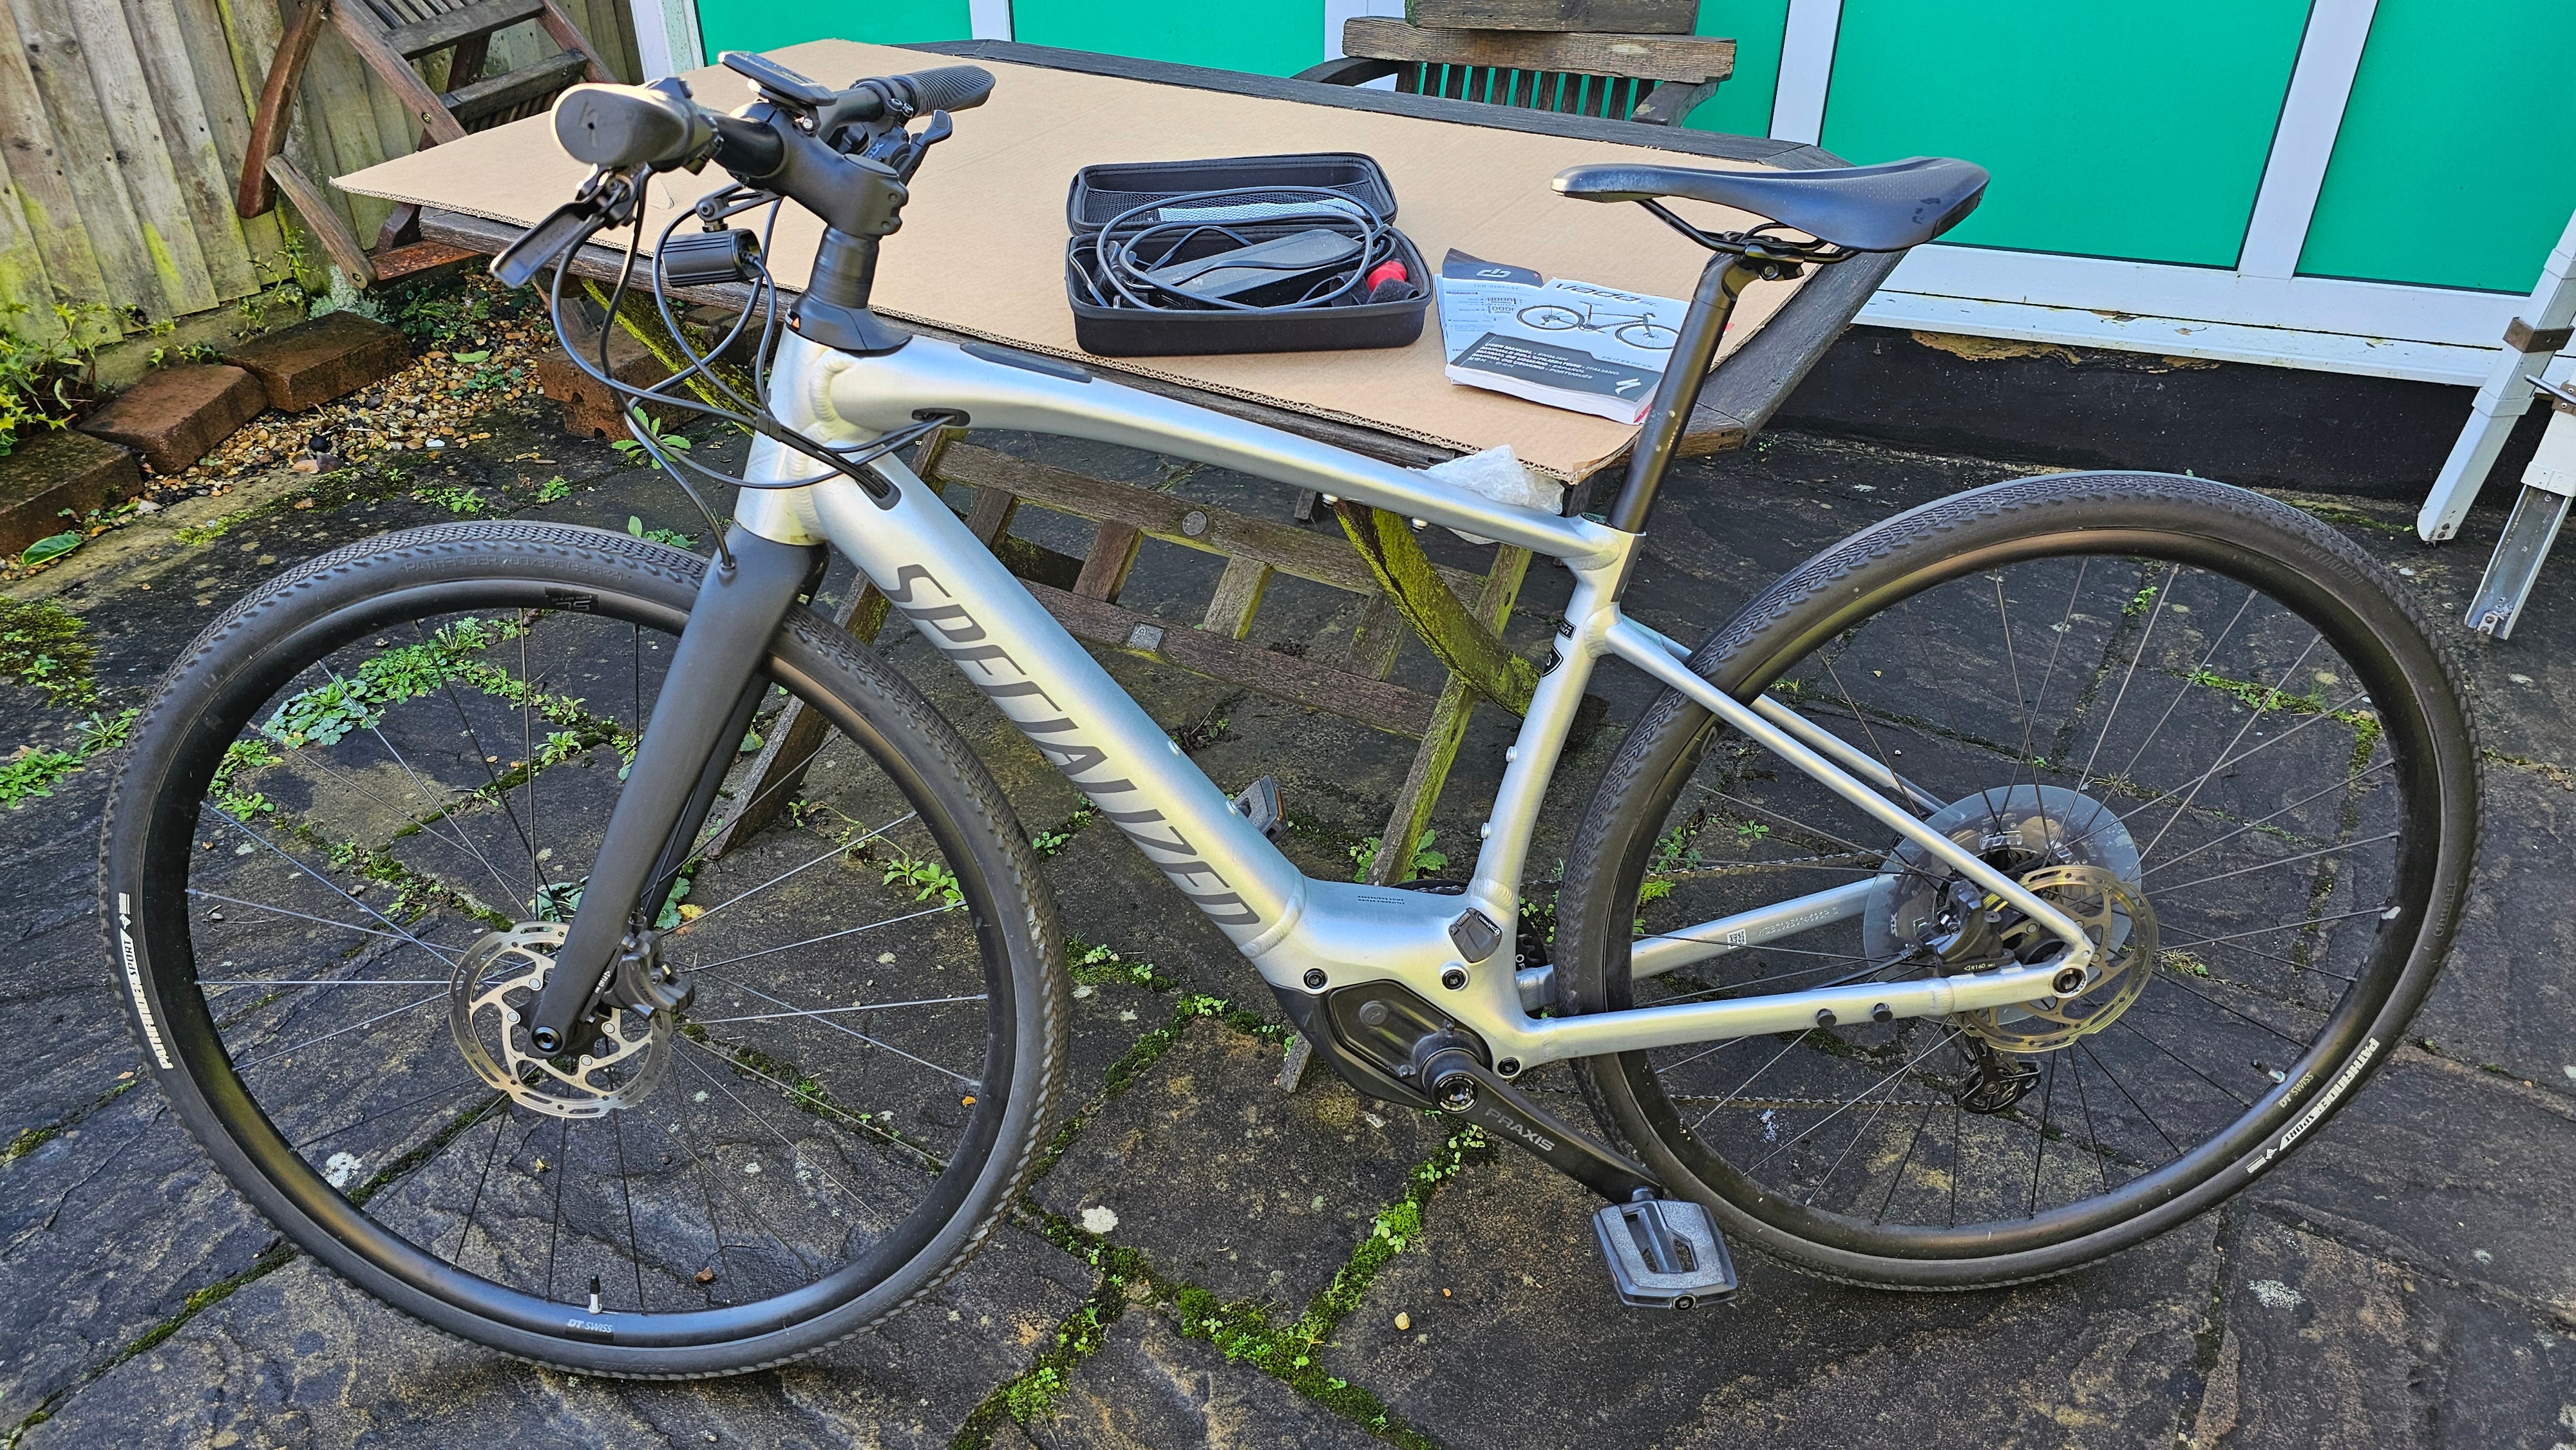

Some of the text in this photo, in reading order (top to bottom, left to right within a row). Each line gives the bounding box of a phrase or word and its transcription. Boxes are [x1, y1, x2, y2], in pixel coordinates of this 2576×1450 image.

[1472, 353, 1501, 361] MANUAL
[1475, 350, 1504, 358] MANUAL
[1504, 345, 1532, 354] MANUAL
[1537, 353, 1568, 361] ENGLISH
[1586, 366, 1620, 375] ITALIANO
[871, 564, 1260, 925] SPECIALIZED
[124, 940, 174, 1069] PATHFINDER SPORT
[2278, 1070, 2315, 1108] DT SWISS
[2284, 1037, 2380, 1143] PATHFINDER SPORT
[1484, 1107, 1555, 1151] PRAXIS
[567, 1319, 613, 1333] DT SWISS
